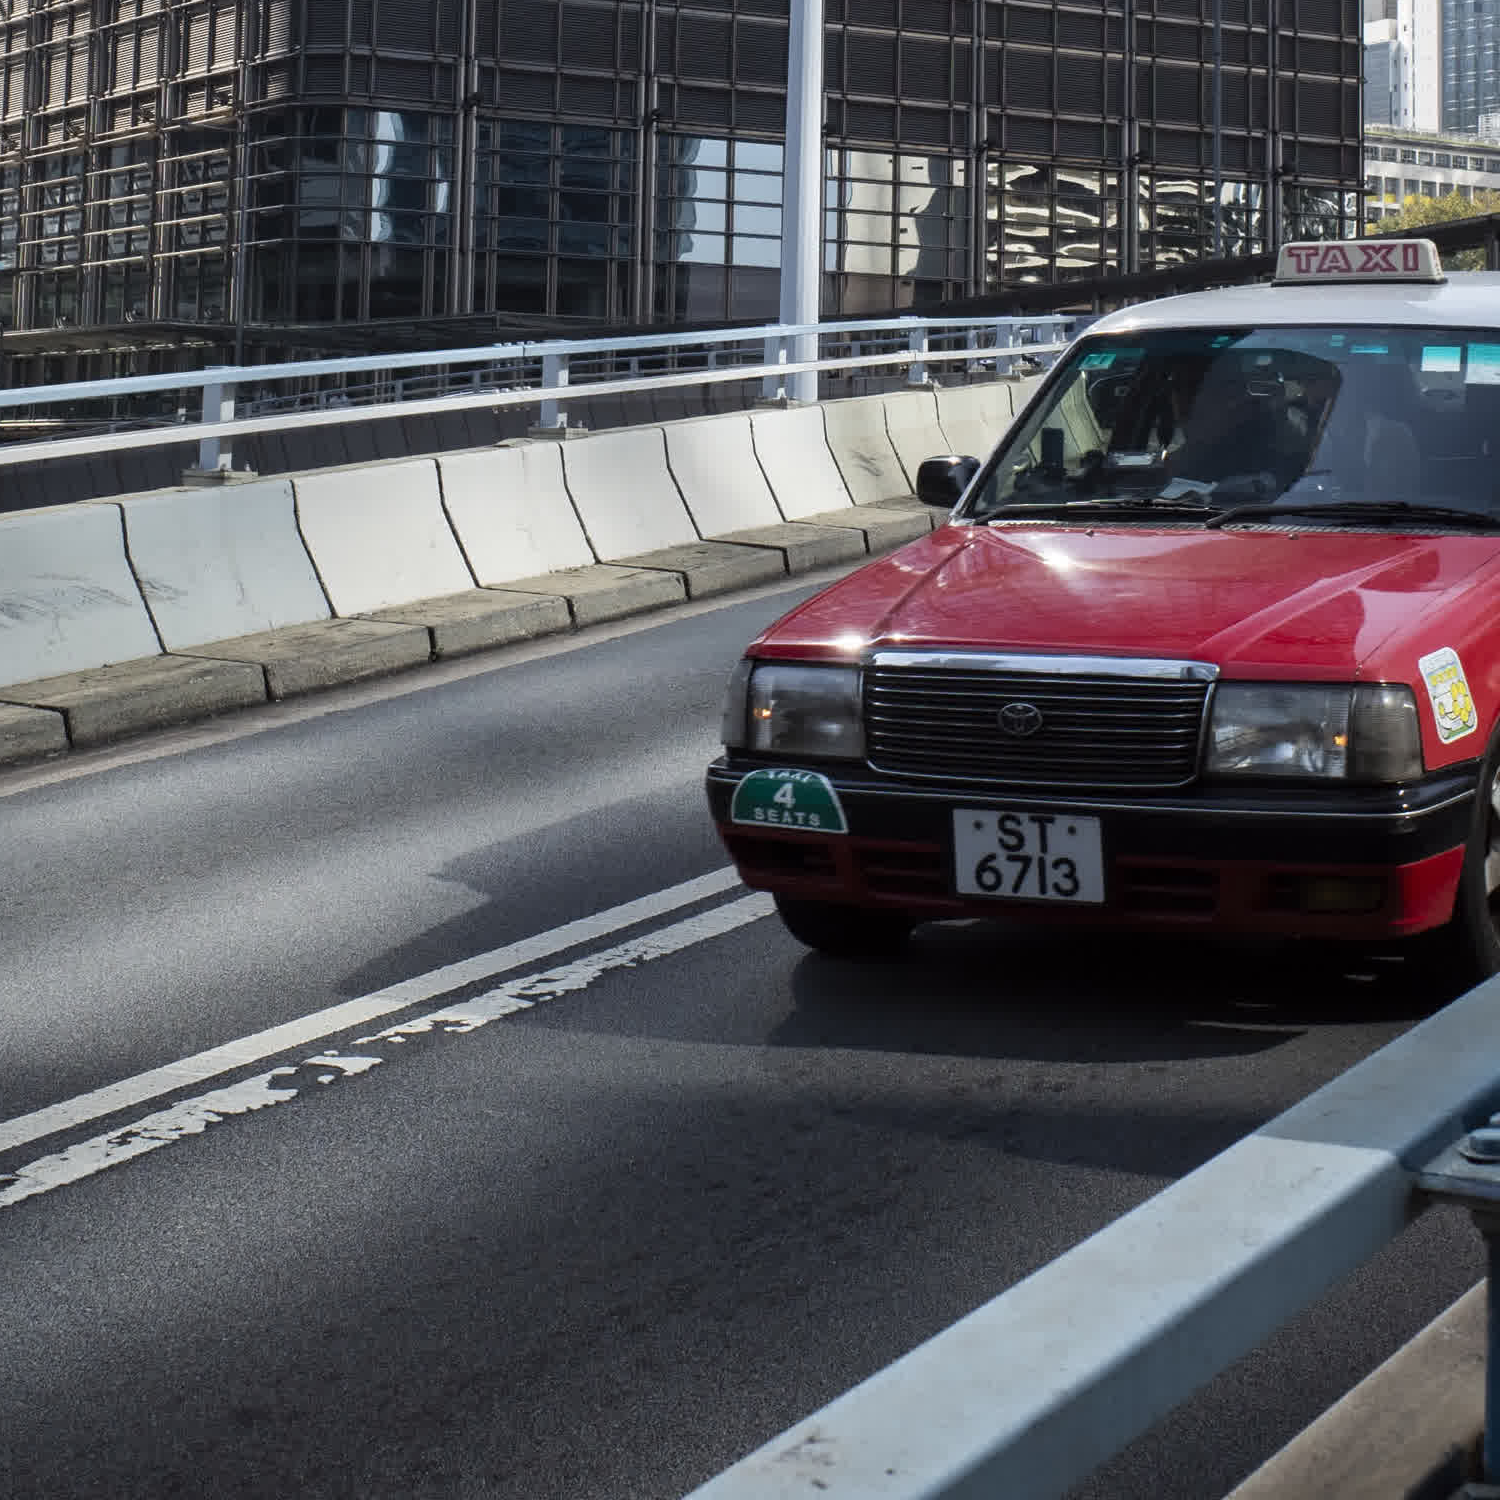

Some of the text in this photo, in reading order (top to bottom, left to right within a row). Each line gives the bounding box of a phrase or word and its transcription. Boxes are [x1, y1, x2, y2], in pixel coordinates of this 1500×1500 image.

[1287, 243, 1420, 274] TAXI
[773, 782, 797, 809] 4
[753, 807, 821, 827] SEATS
[997, 813, 1056, 854] ST
[975, 853, 1080, 897] 6713
